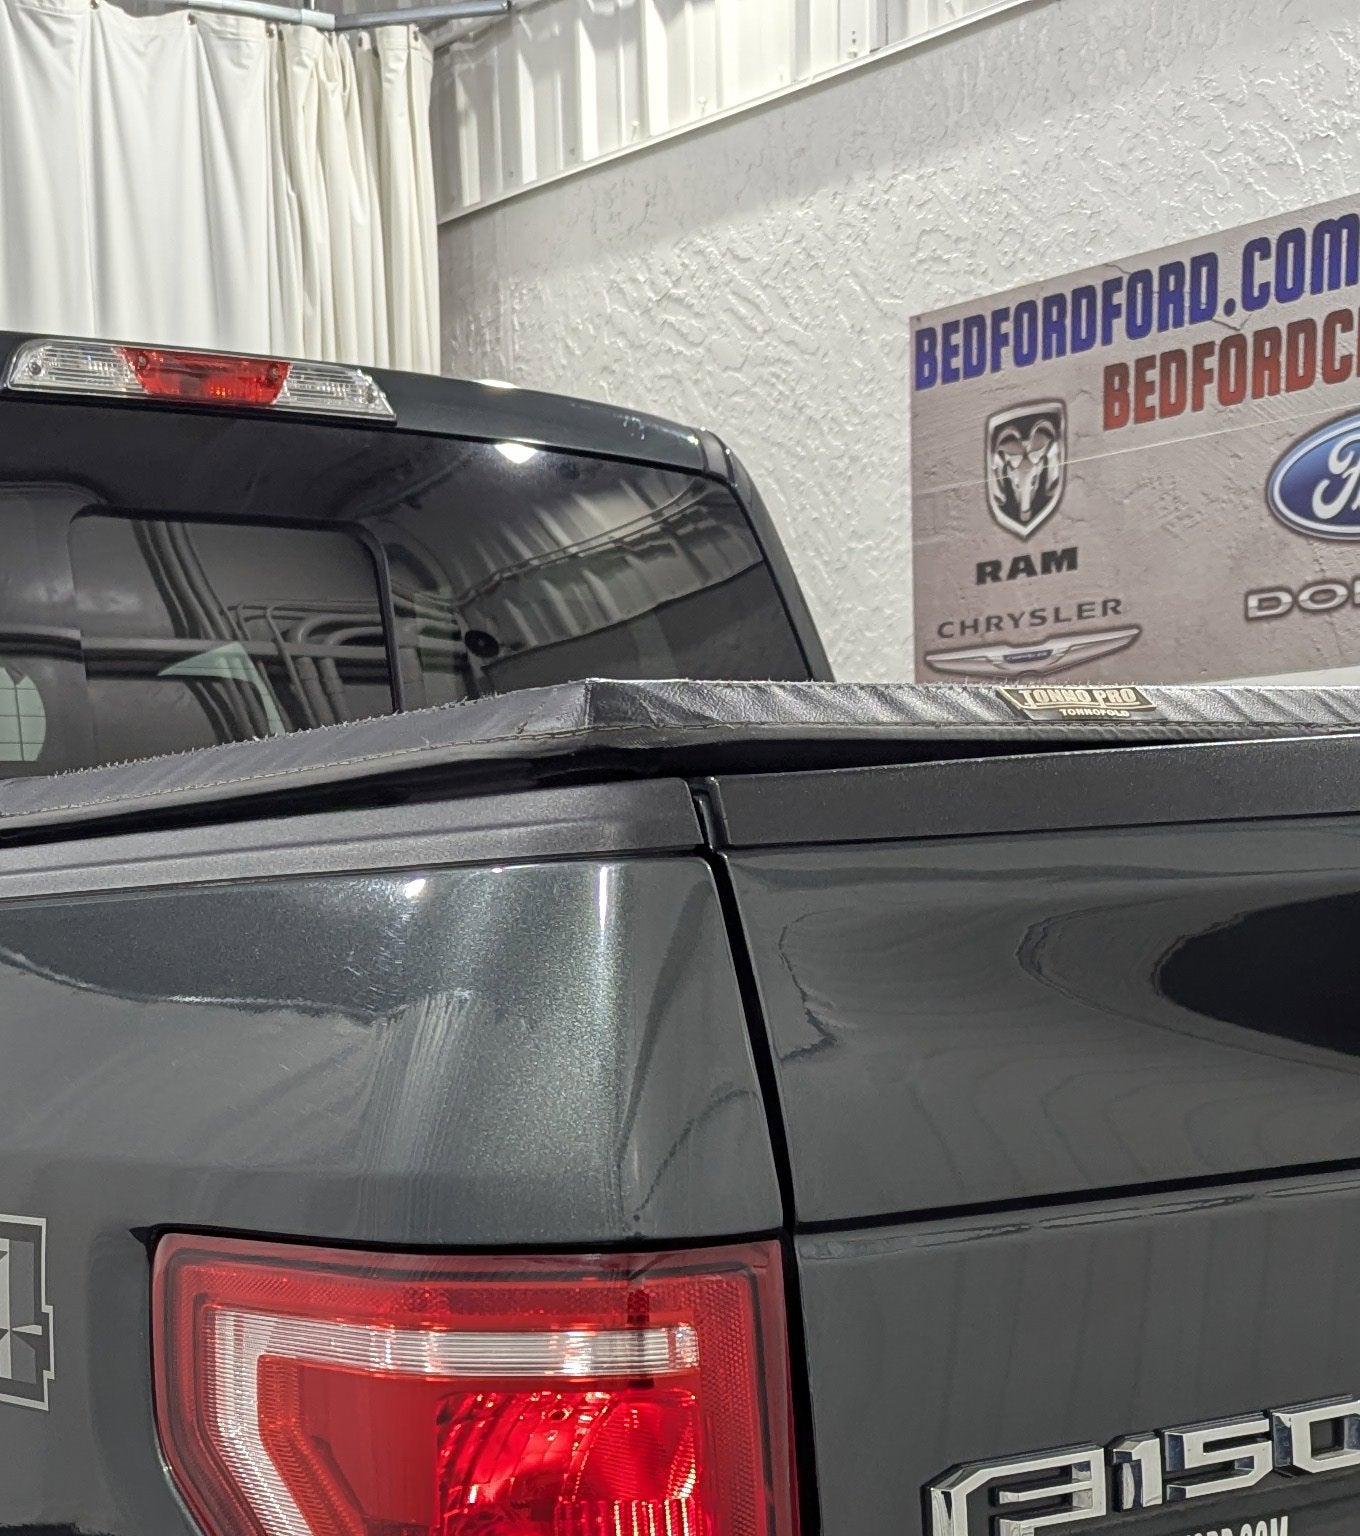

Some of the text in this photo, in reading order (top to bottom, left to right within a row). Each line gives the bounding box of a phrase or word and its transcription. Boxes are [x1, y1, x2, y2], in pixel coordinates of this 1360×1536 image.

[915, 213, 1360, 391] BEDFORDFORD.COM
[976, 547, 1078, 585] RAM
[937, 598, 1122, 638] CHRYSLER
[1019, 688, 1137, 708] TONNO PRO
[1060, 708, 1130, 717] TONNOFOLD
